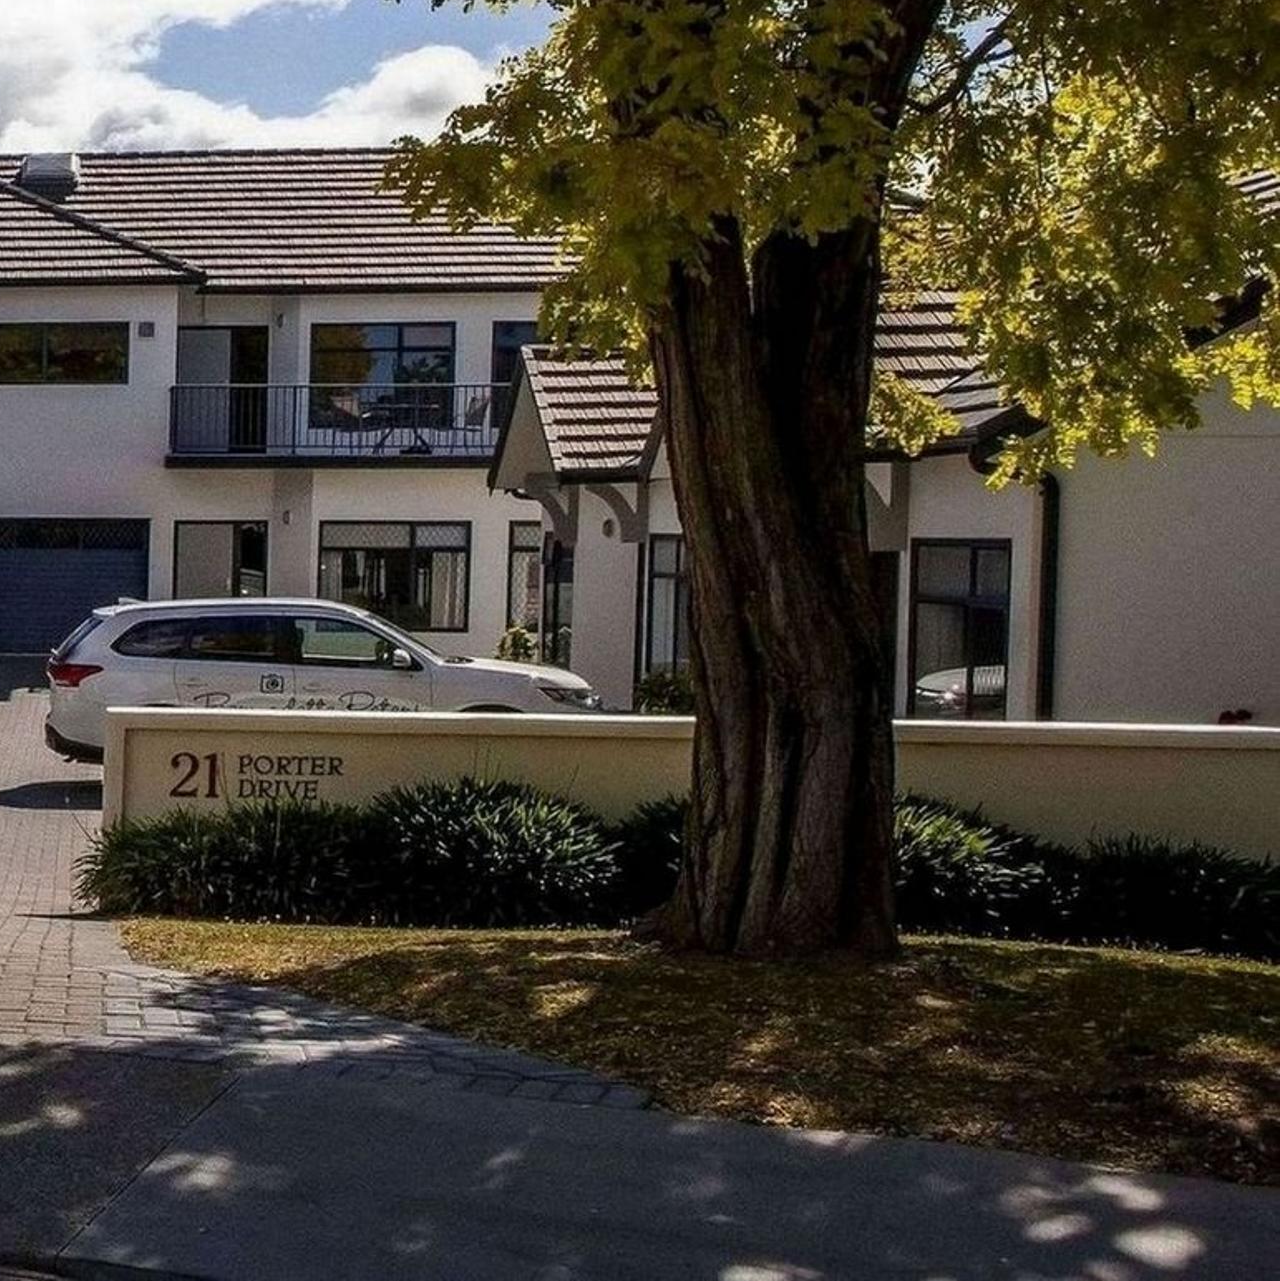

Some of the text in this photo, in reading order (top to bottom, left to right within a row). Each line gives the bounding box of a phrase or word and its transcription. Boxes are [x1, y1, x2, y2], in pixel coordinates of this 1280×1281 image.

[168, 751, 345, 799] 21 PORTER
[237, 778, 320, 801] DRIVE
